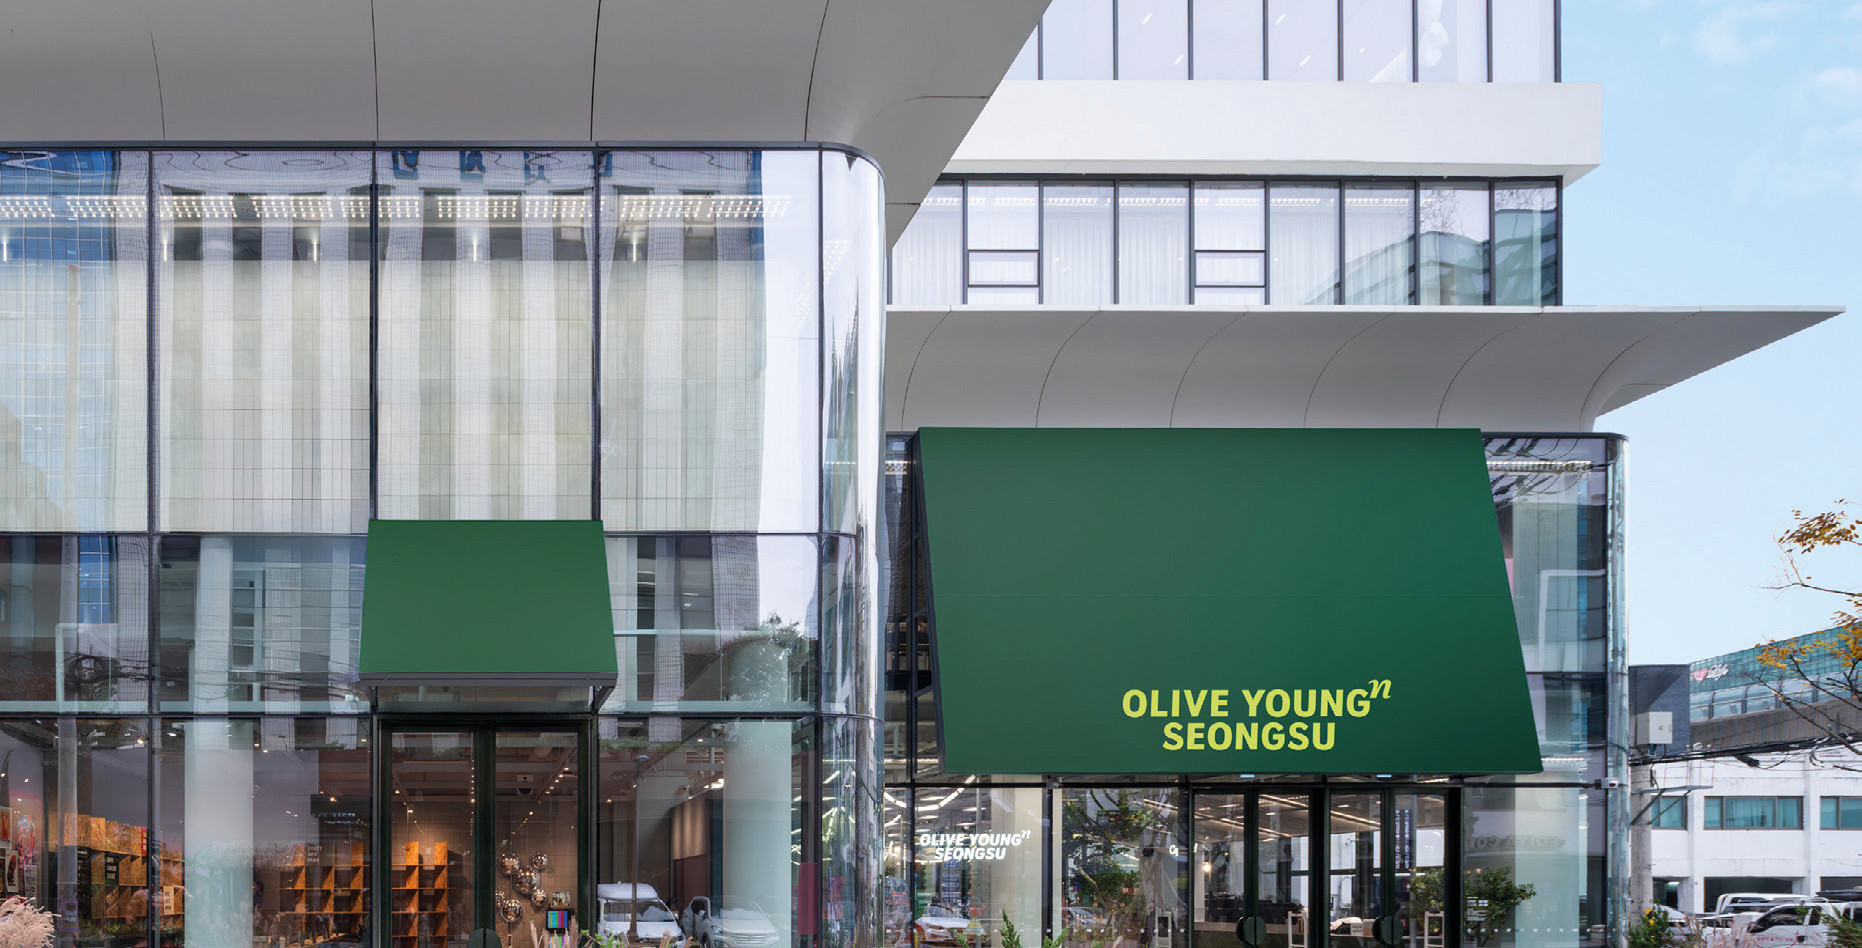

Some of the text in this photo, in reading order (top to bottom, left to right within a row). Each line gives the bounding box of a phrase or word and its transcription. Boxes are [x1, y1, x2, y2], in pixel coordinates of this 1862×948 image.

[1122, 689, 1229, 718] OLIVE
[1162, 721, 1336, 751] SEONGSU
[919, 833, 965, 846] OLIVE
[934, 847, 1007, 860] SEONGSU
